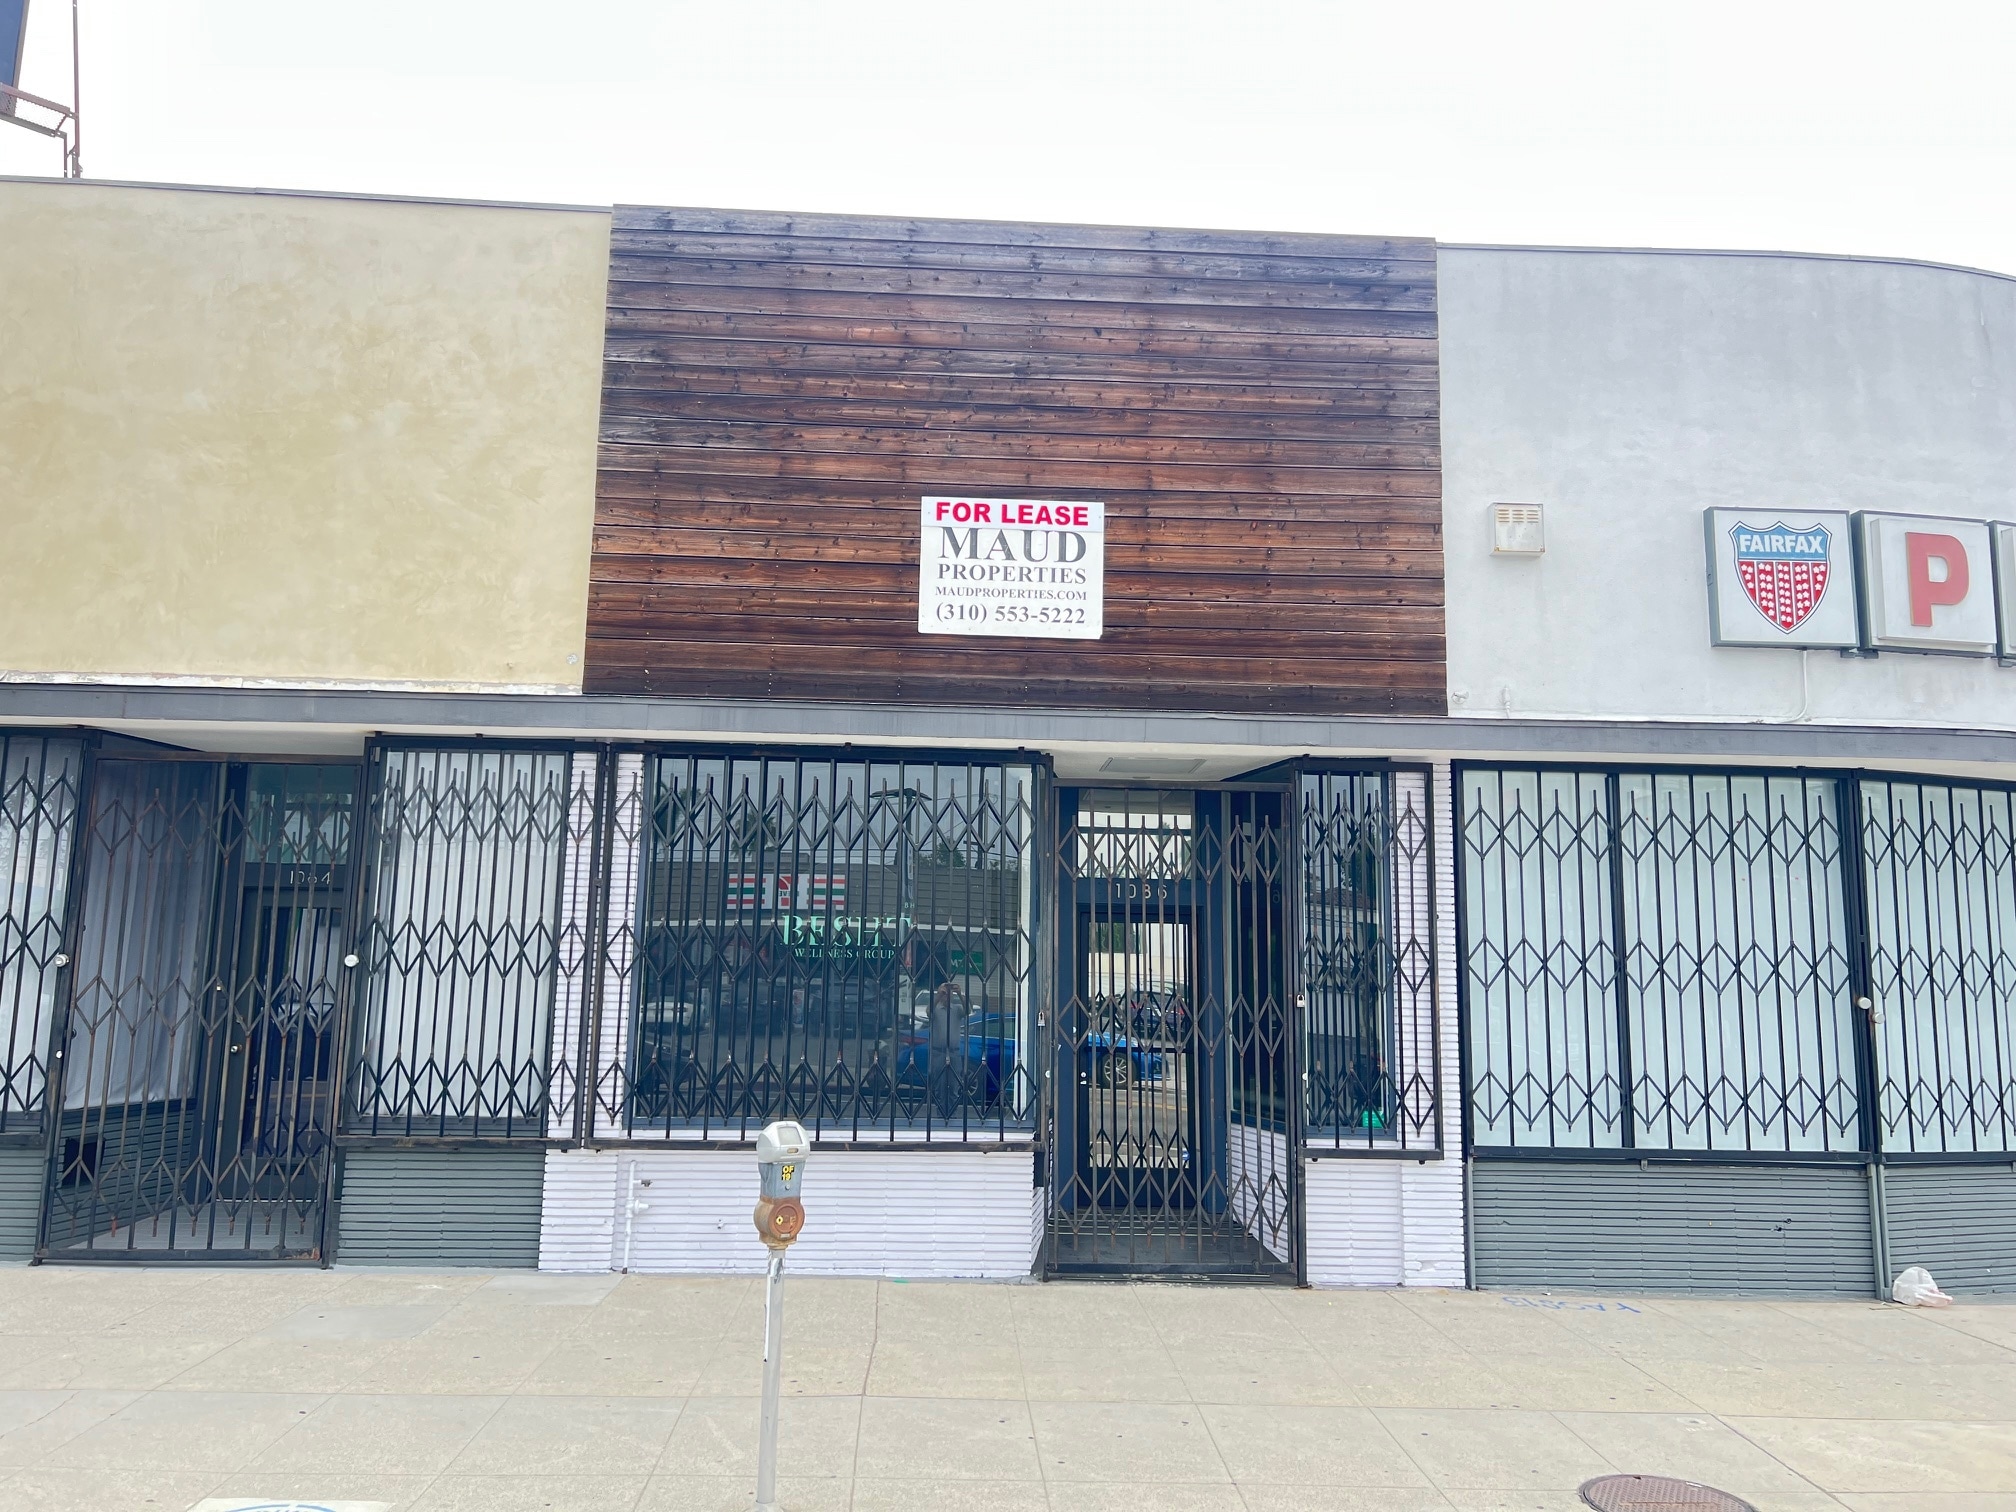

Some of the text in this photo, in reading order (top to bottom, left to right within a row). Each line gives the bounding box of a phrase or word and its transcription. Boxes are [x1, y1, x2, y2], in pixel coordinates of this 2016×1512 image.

[936, 502, 1089, 526] FOR LEASE
[937, 526, 1087, 563] MAUD
[1738, 534, 1825, 555] FAIRFAX
[937, 563, 1087, 585] PROPERTIES
[1904, 531, 1971, 628] P
[935, 586, 1088, 601] MAUDPROPERTIES.COM
[936, 602, 1086, 625] (310) 553-5222
[794, 949, 853, 959] WLLNES
